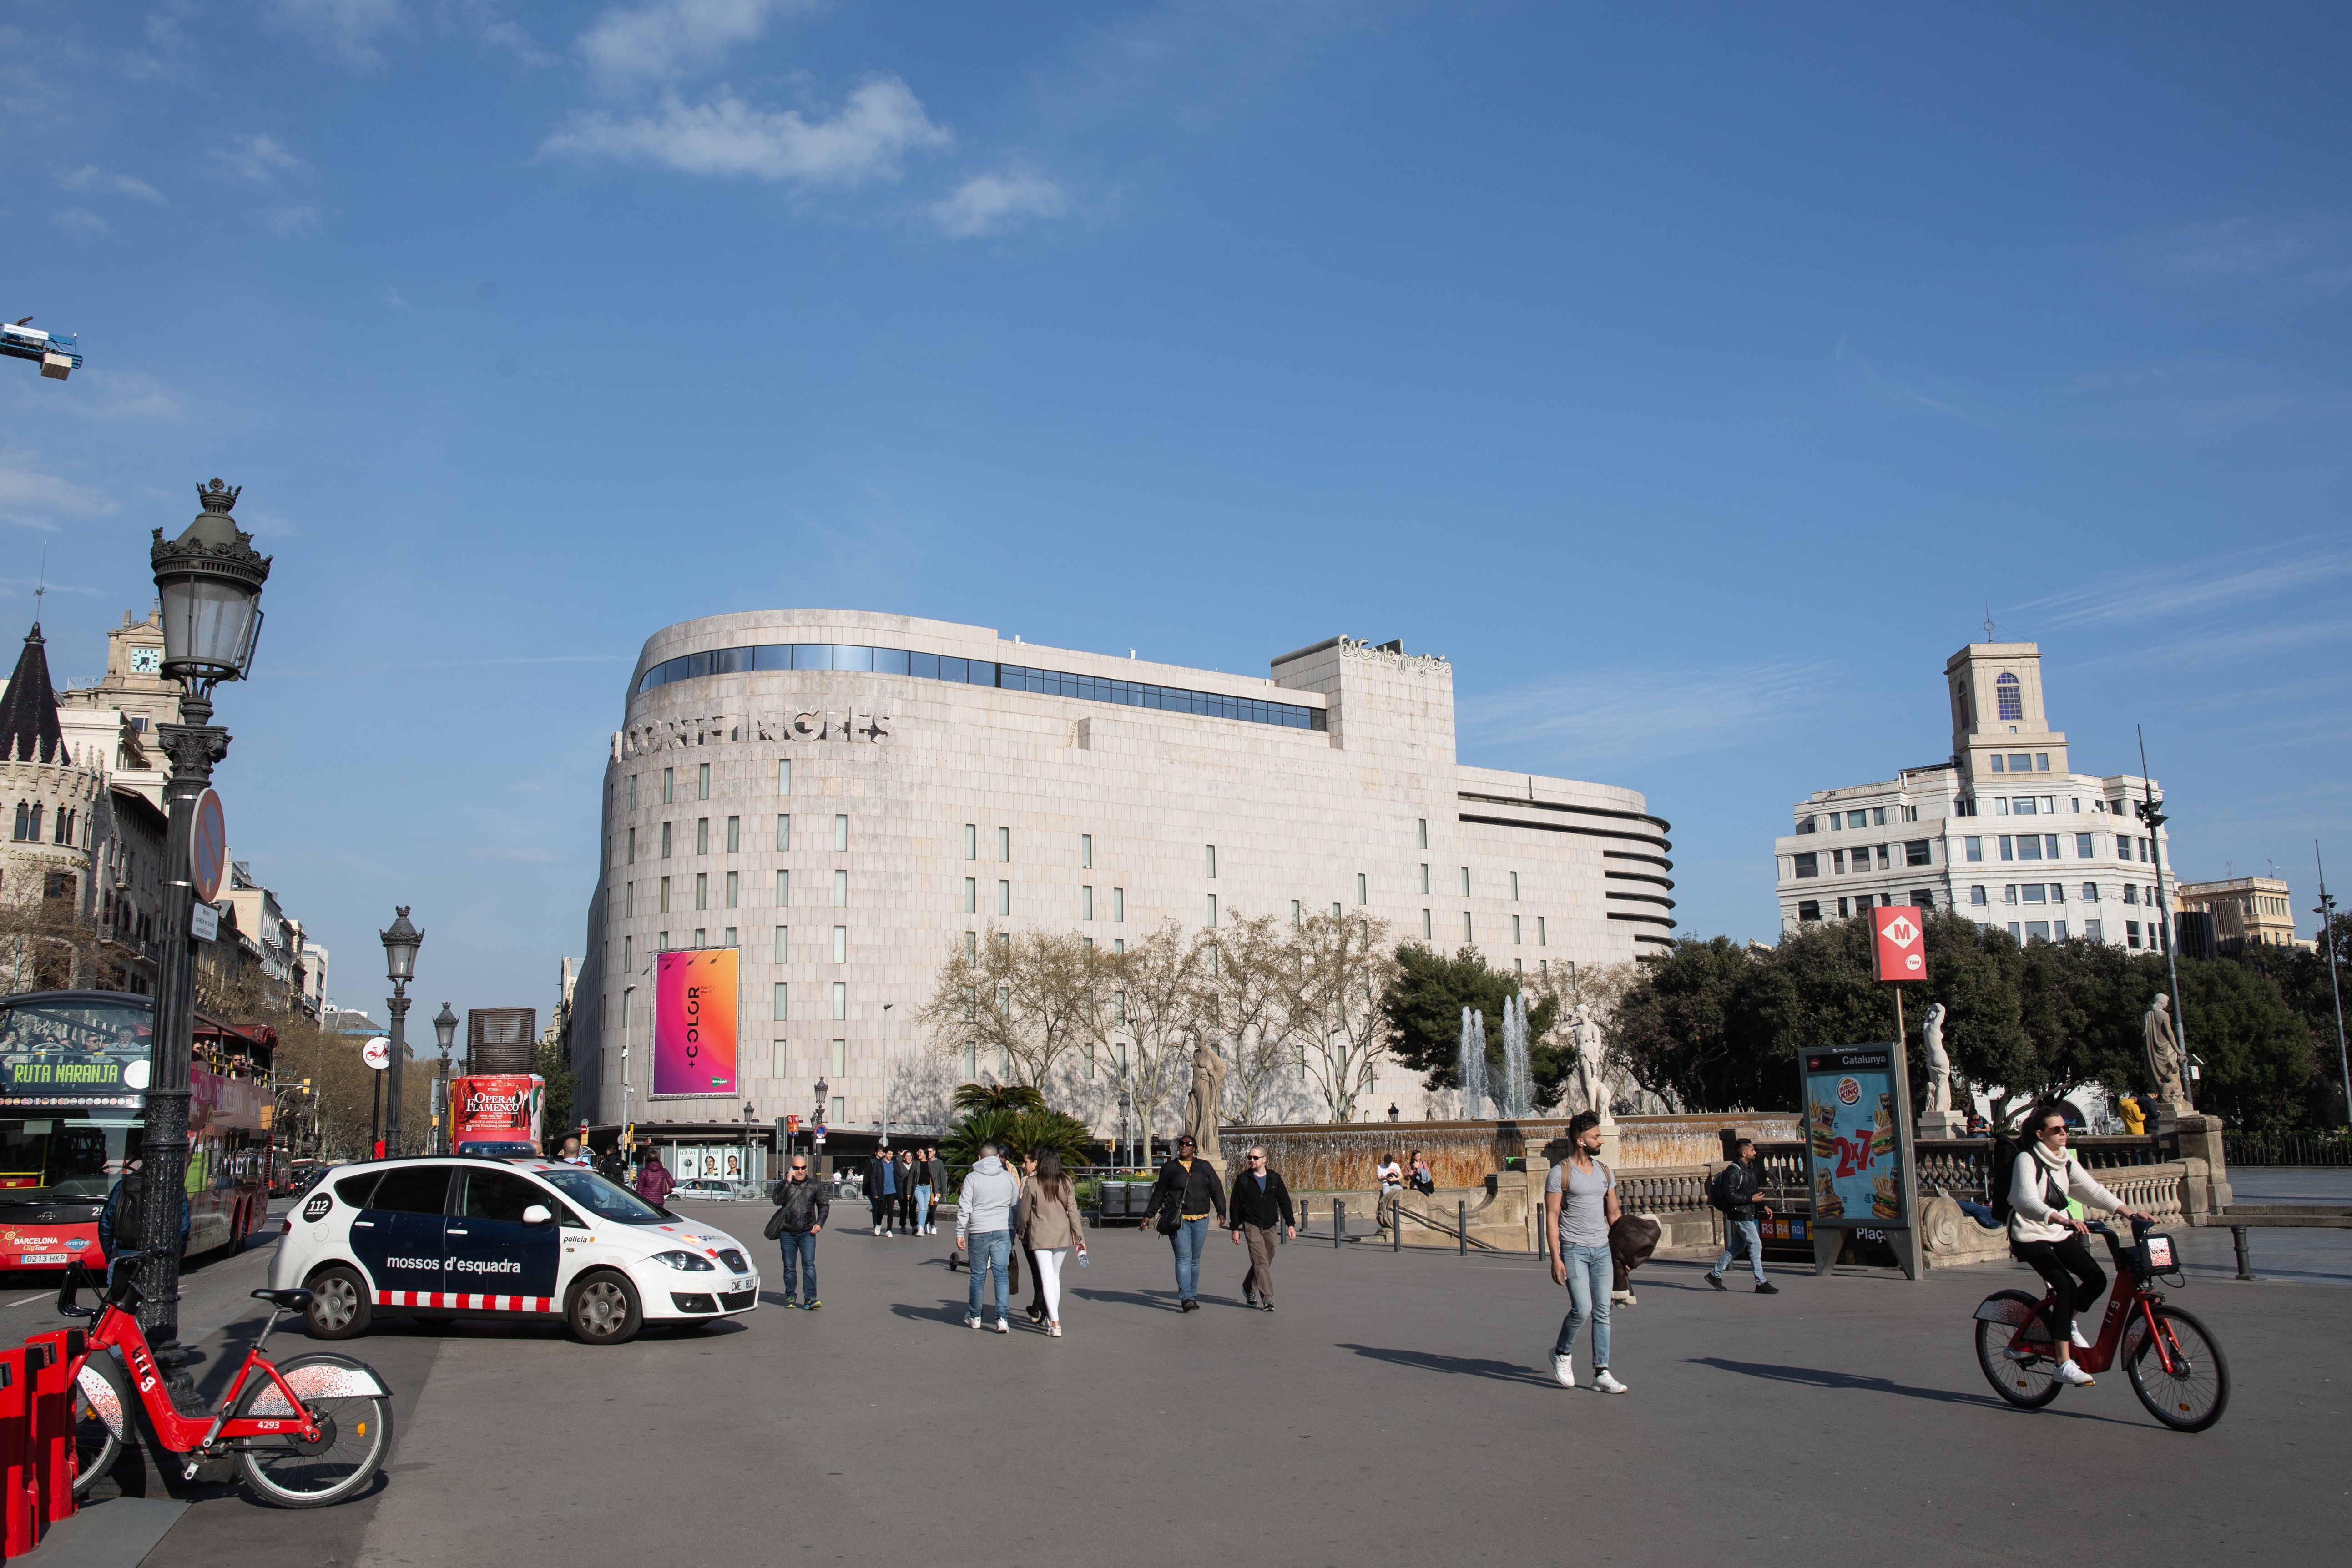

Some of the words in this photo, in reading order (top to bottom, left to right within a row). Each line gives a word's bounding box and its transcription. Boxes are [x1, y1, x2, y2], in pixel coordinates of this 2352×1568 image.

[1339, 634, 1358, 657] El
[1358, 638, 1396, 665] Corte
[1398, 638, 1452, 677] Inglés
[7, 849, 67, 865] Catalana
[1894, 924, 1911, 940] M
[1842, 1055, 1886, 1065] Catalunya
[14, 1064, 51, 1083] RUTA
[55, 1064, 118, 1083] NARANJA
[1839, 1082, 1857, 1092] BURGER
[1840, 1087, 1859, 1100] KING
[466, 1098, 519, 1112] FLAMENCO
[308, 1200, 329, 1211] 112
[1761, 1223, 1774, 1234] R3
[1776, 1224, 1789, 1234] R4
[1792, 1226, 1804, 1234] RG1
[1856, 1228, 1886, 1243] Plaç
[387, 1256, 439, 1270] mossos
[444, 1256, 521, 1275] d'esquadra
[732, 1281, 741, 1291] CME
[745, 1278, 754, 1289] 1832
[131, 1345, 156, 1392] bicing
[257, 1421, 279, 1429] 4293
